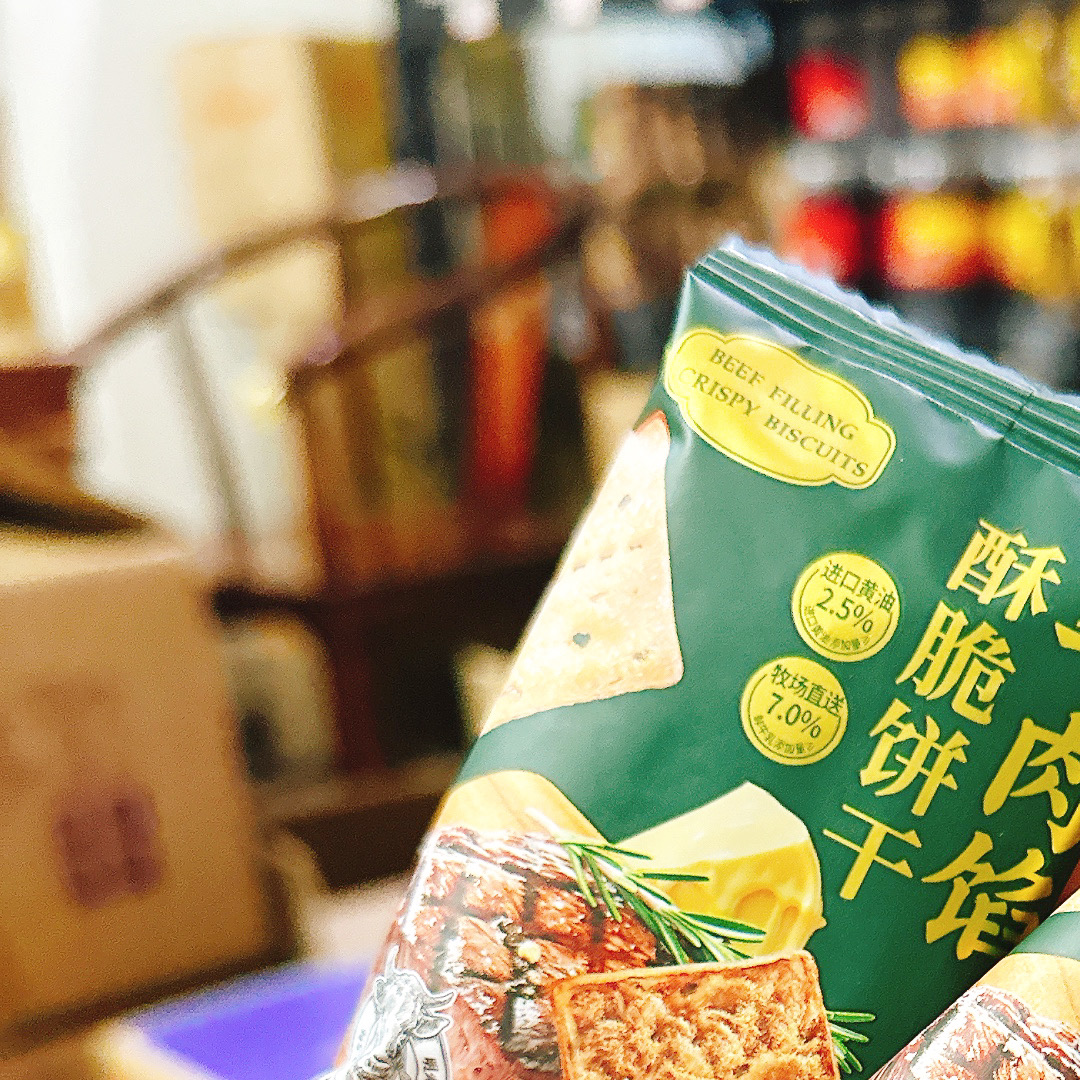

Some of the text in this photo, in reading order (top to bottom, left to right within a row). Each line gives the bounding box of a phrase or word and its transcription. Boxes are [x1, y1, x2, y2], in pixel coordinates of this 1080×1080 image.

[678, 366, 870, 478] CRISPY BISCUITS
[709, 348, 860, 441] BEEF FILLING
[816, 587, 874, 633] 2.5%
[820, 559, 897, 614] 进口黄油
[767, 691, 822, 739] 7.0%
[771, 664, 846, 719] 牧场直送
[822, 518, 1067, 901] 酥脆饼干
